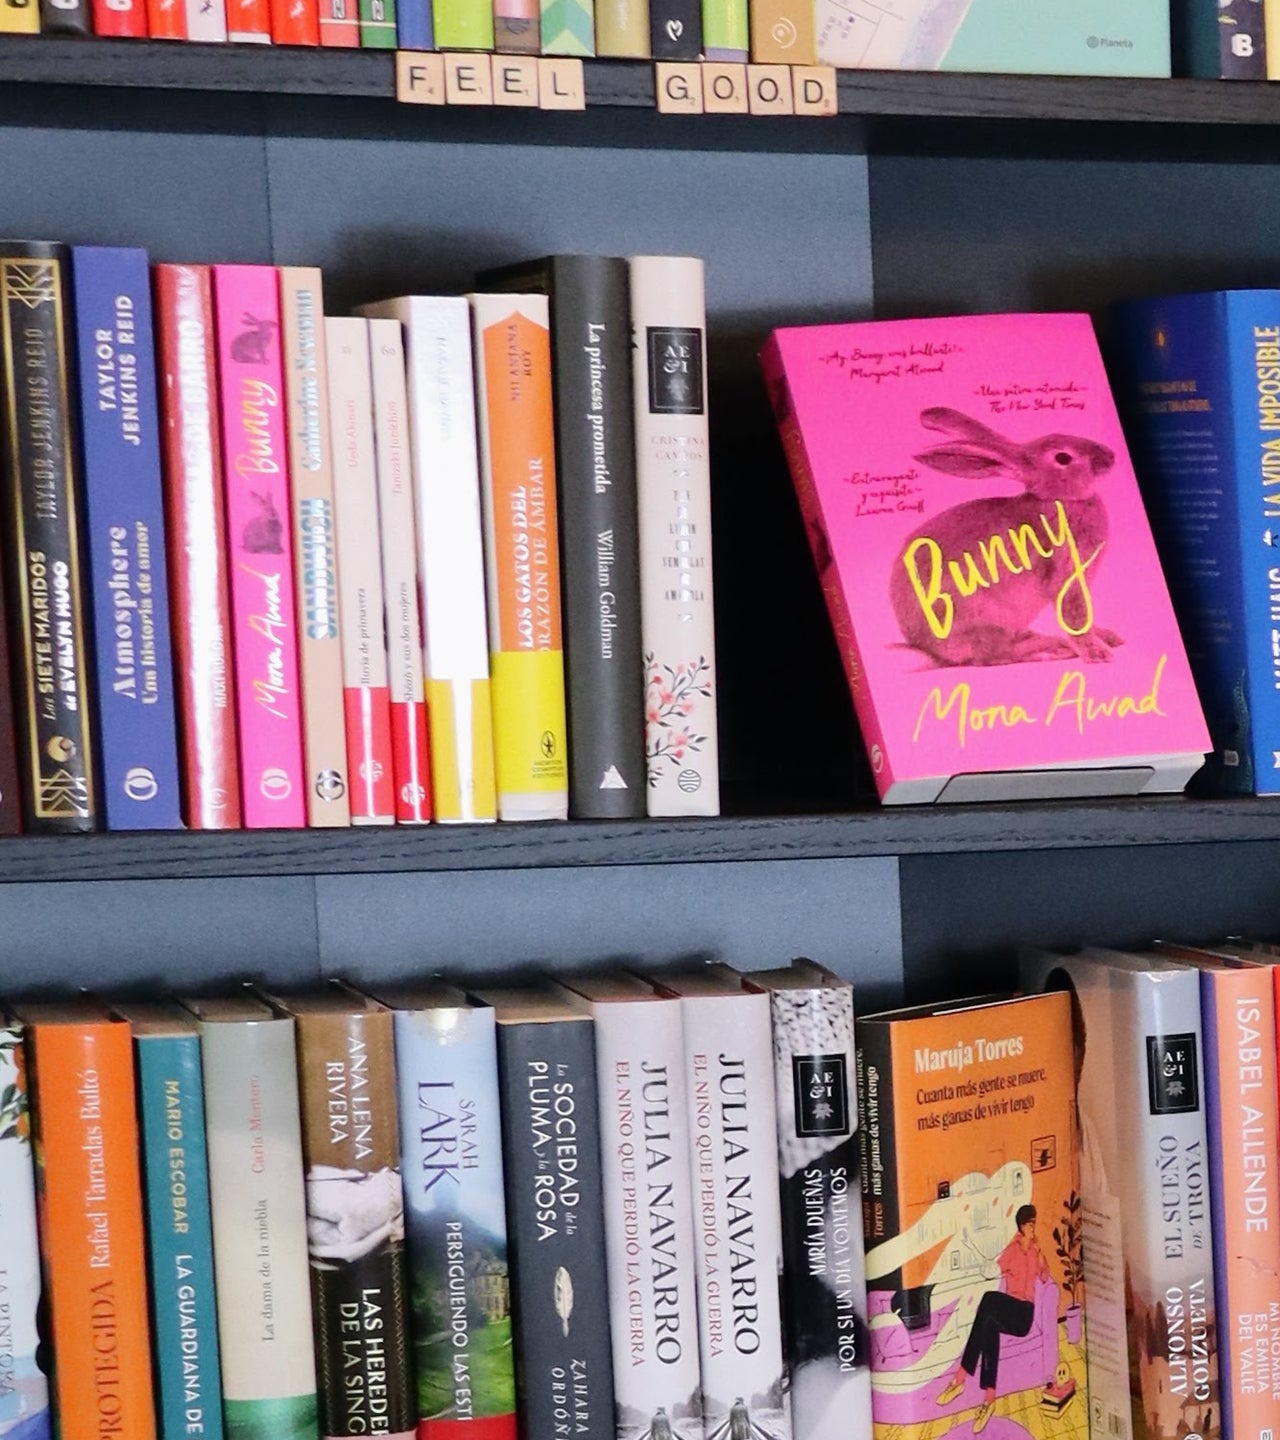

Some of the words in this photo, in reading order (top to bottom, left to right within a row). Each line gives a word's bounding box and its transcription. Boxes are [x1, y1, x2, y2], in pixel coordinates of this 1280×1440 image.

[904, 501, 1104, 639] Bunny
[914, 684, 1038, 749] Mona
[1048, 655, 1167, 733] Awad
[914, 1044, 972, 1072] Maruja
[978, 1036, 1024, 1063] Torres
[1237, 997, 1263, 1097] ISABEL
[165, 1081, 182, 1141] MARIO
[641, 1060, 670, 1171] JULIA
[170, 1148, 189, 1234] ESCOBAR
[1243, 1106, 1269, 1234] ALLENDE
[649, 1184, 681, 1366] NAVARRO
